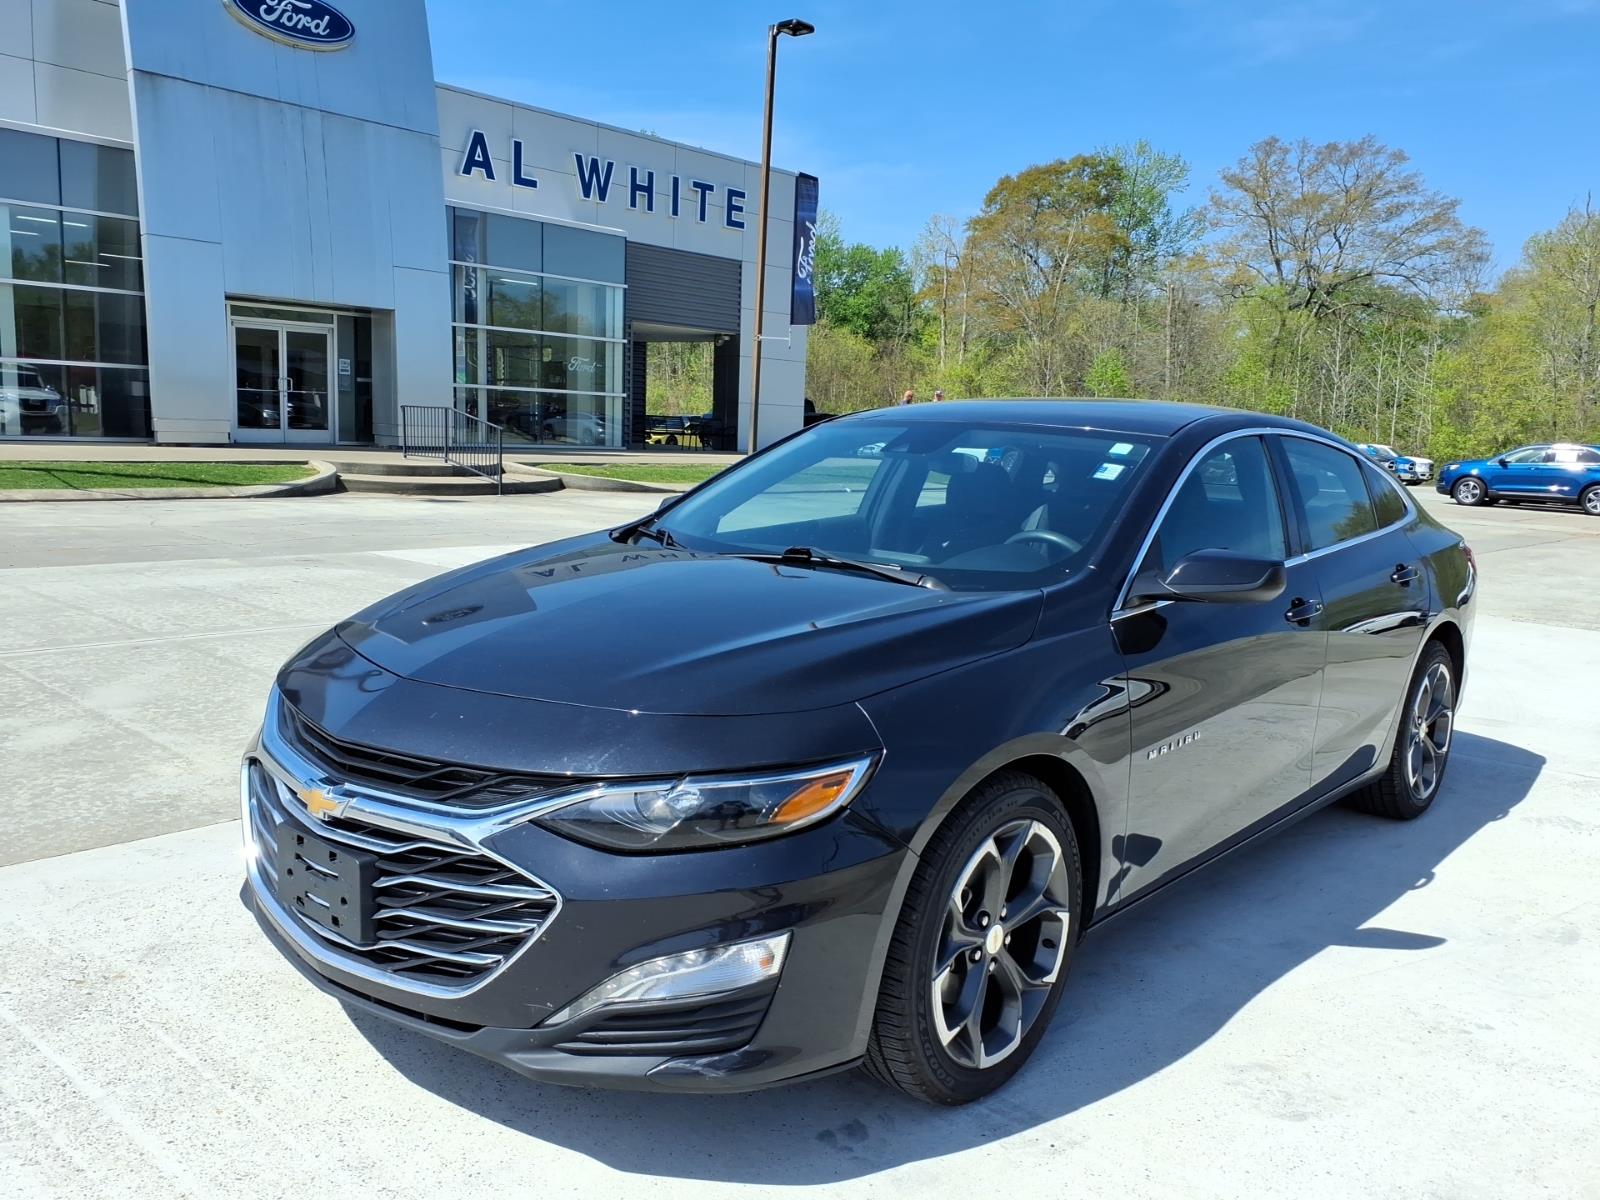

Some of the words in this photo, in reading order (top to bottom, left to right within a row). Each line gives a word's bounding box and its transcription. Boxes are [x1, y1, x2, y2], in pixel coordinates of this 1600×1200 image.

[260, 0, 330, 35] Ford
[461, 130, 539, 189] AL
[573, 152, 747, 231] WHITE
